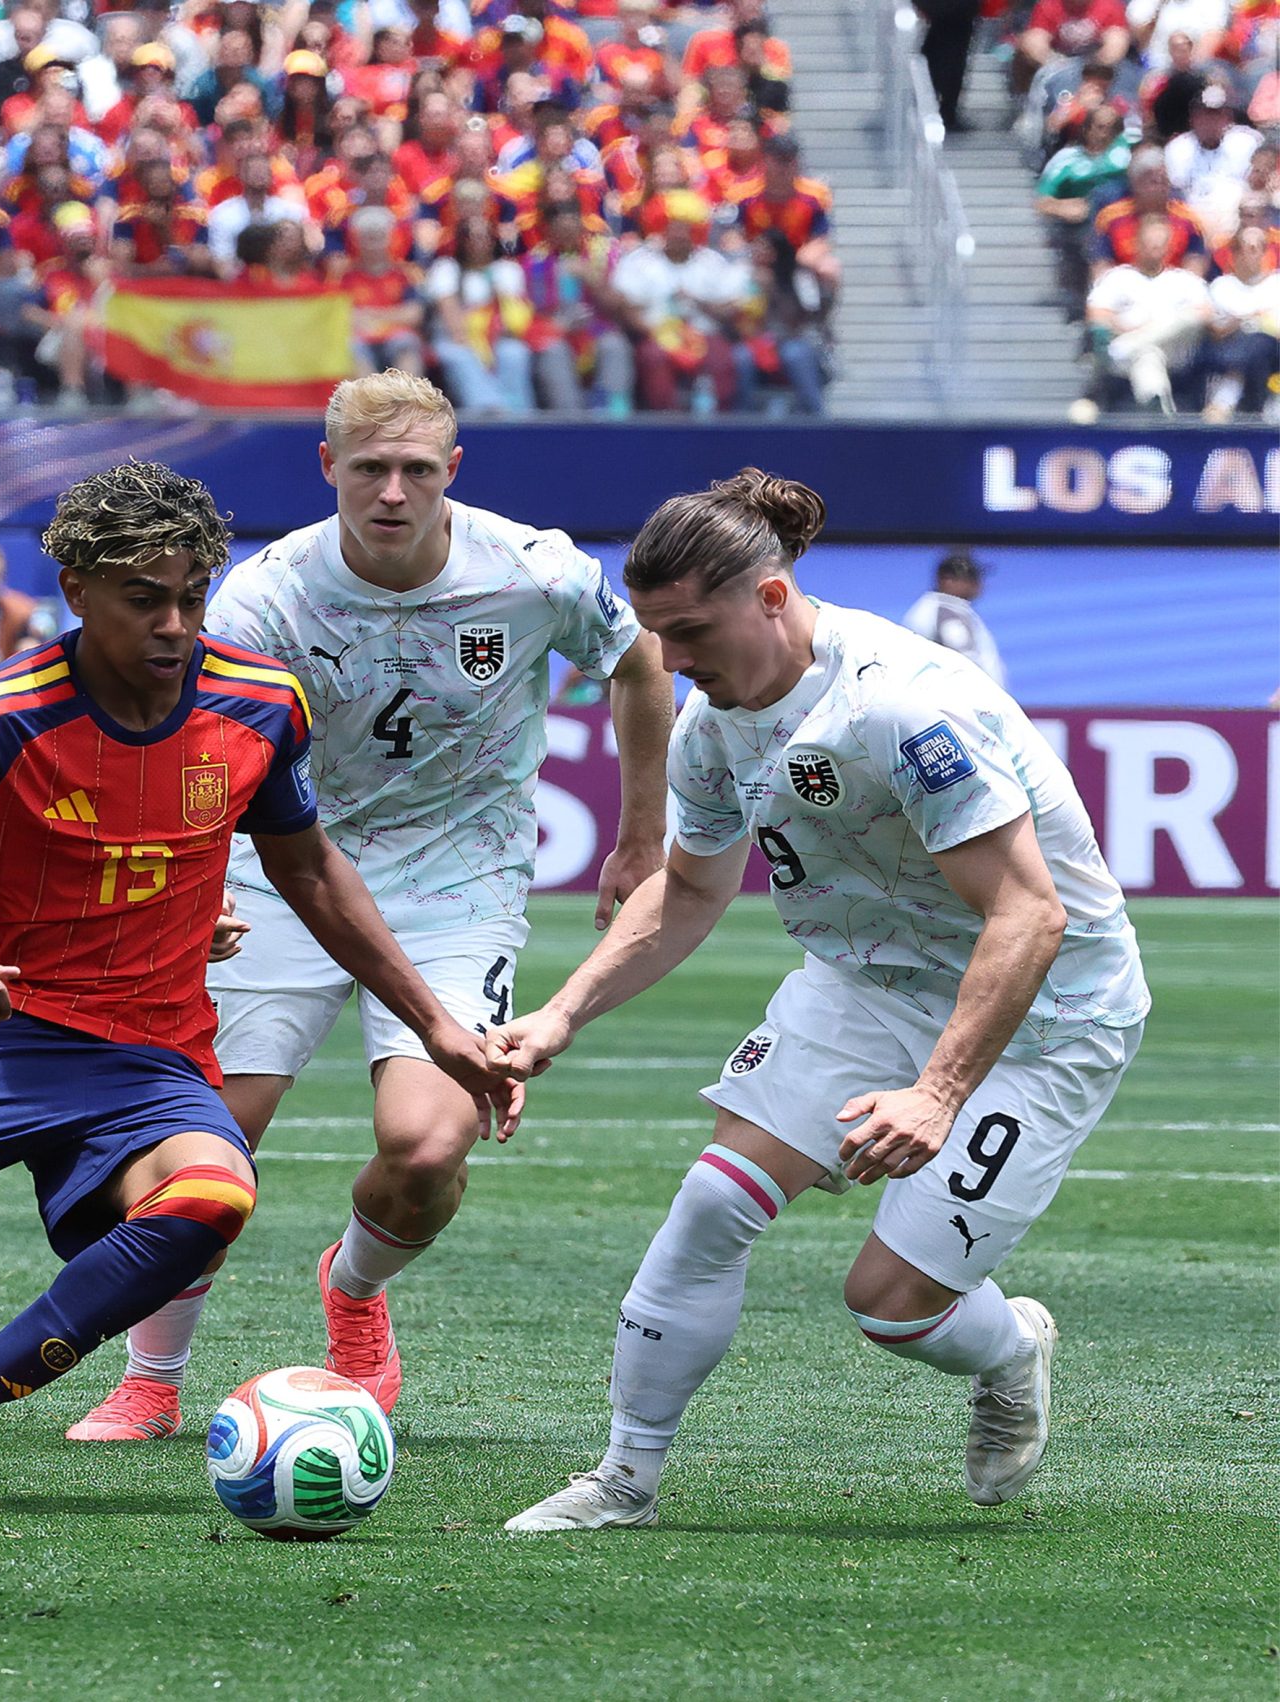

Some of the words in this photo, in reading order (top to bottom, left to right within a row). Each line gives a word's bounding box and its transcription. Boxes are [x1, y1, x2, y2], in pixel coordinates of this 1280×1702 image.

[983, 445, 1172, 514] LOS
[1193, 446, 1280, 514] A
[372, 688, 414, 759] 4
[919, 740, 956, 767] UNITES
[758, 826, 807, 890] 9
[948, 1112, 1021, 1203] 9
